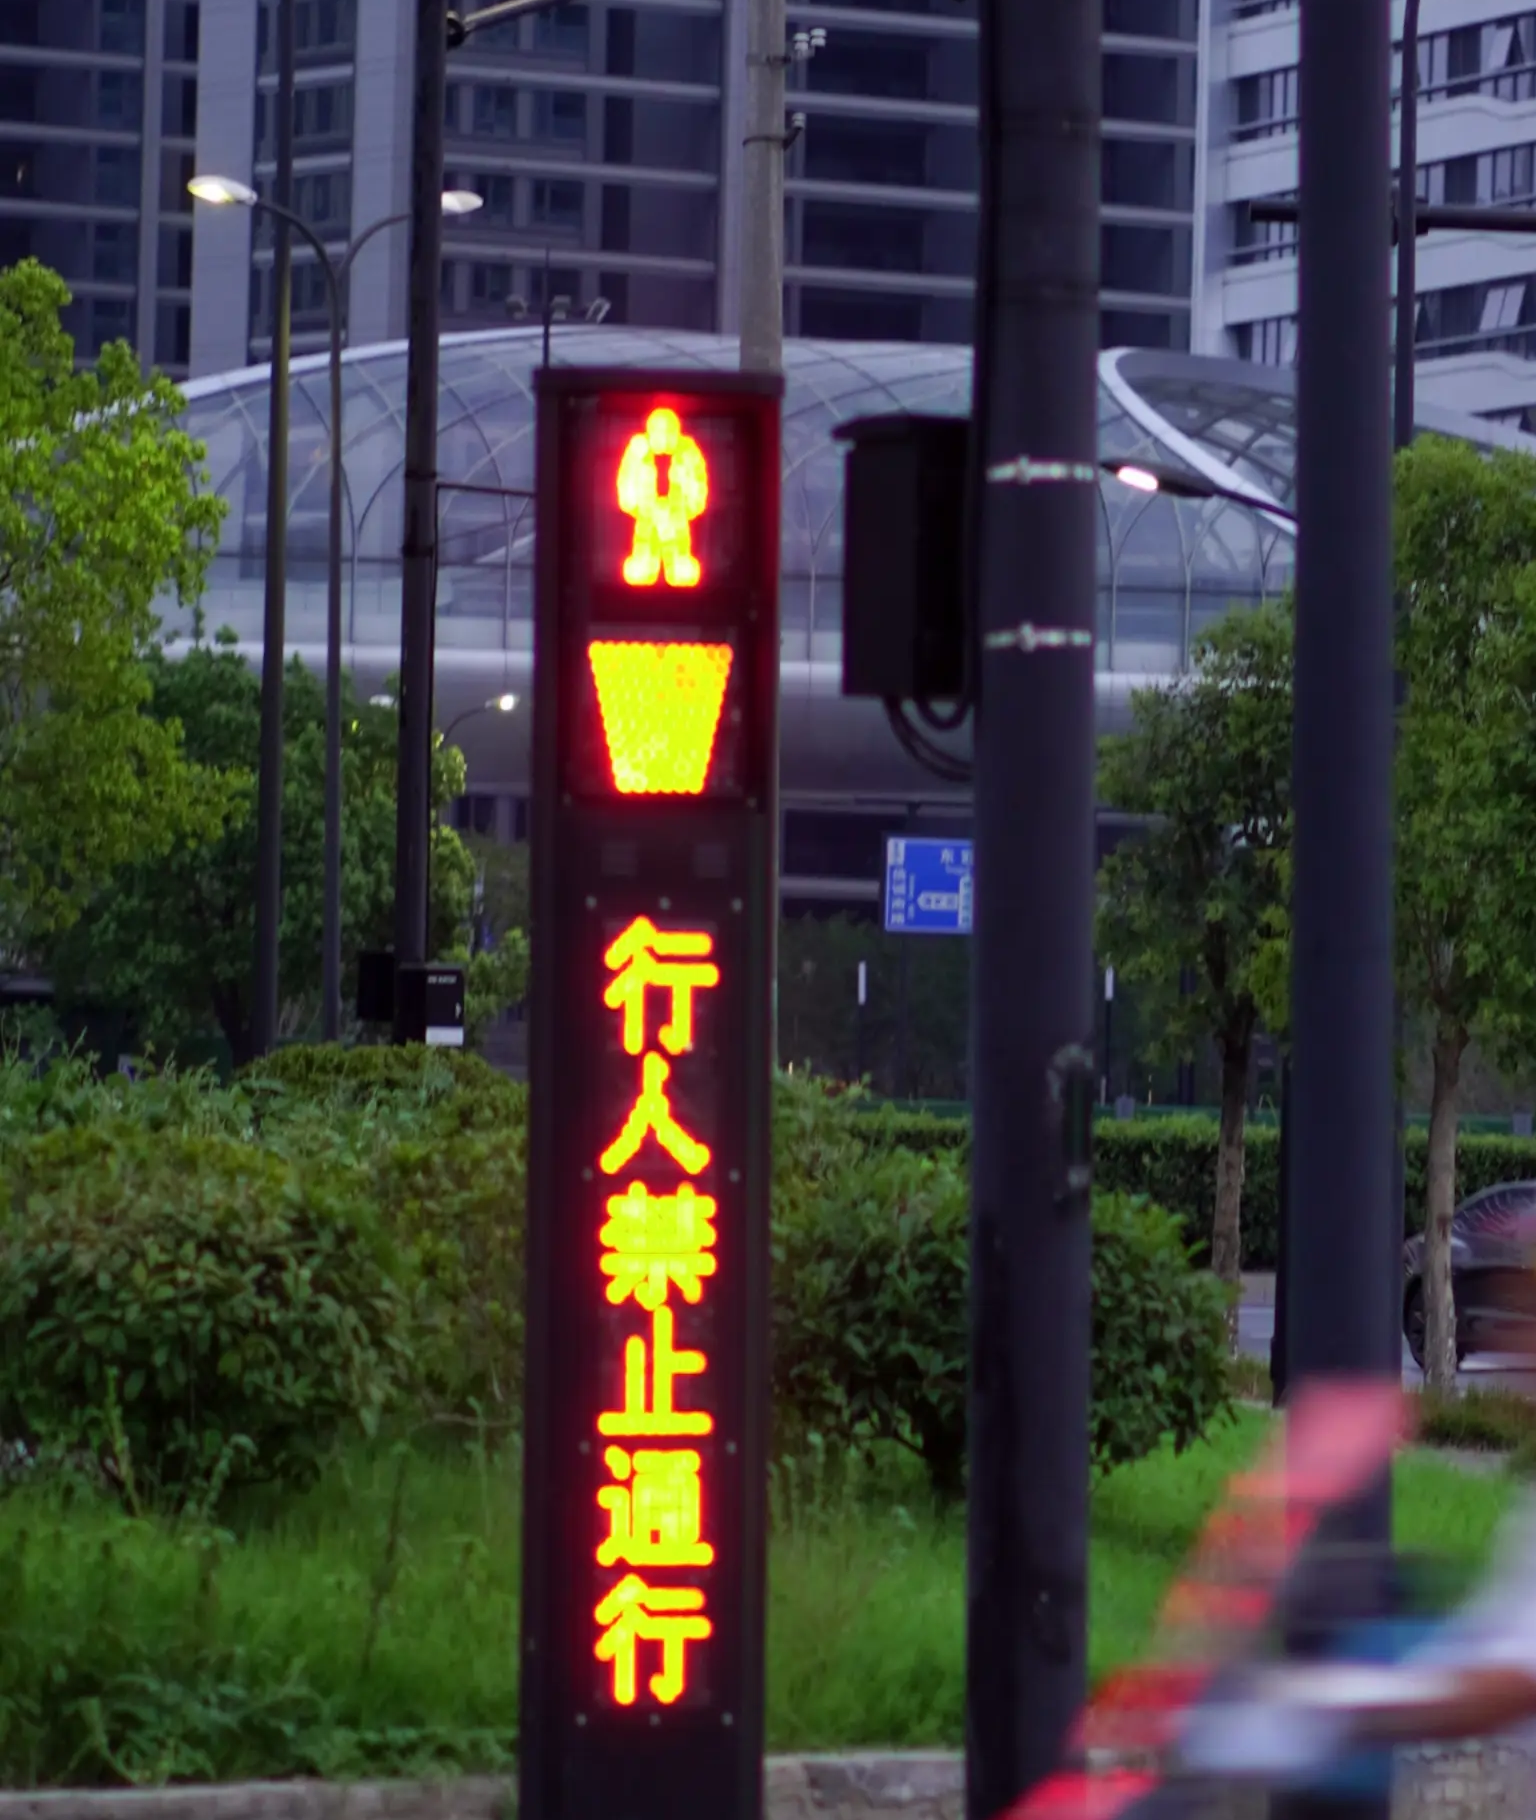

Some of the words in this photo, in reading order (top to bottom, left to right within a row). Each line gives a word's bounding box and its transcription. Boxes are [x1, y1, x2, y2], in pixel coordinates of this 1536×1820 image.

[593, 916, 721, 1707] 行人禁止通行
